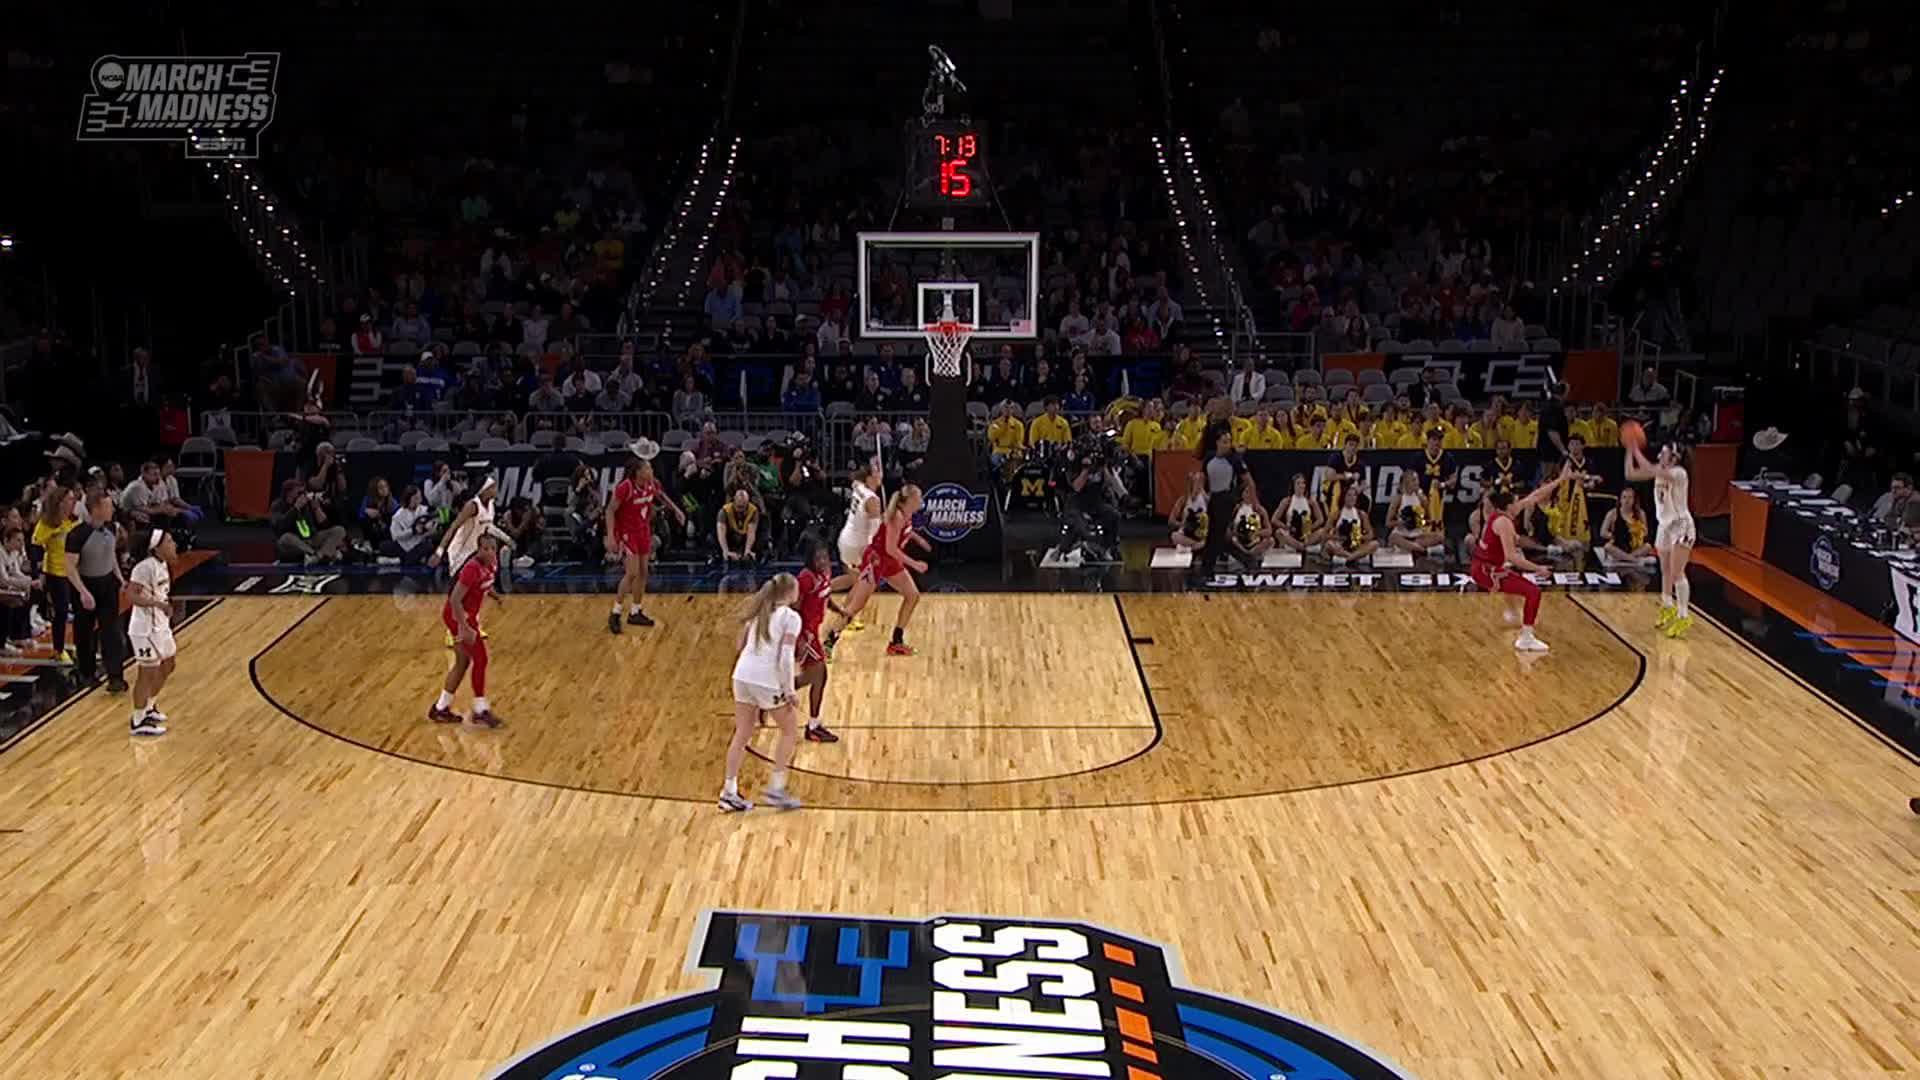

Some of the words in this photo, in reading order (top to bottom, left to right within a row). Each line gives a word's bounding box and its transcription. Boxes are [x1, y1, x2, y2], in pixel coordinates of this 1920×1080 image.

[935, 135, 976, 157] 7:13
[941, 160, 972, 196] 15
[1021, 479, 1045, 497] M
[926, 499, 967, 512] MARCH
[930, 511, 985, 523] MADNESS
[1206, 573, 1382, 587] SWEET
[1400, 572, 1623, 588] SIXEEN
[932, 921, 1113, 1080] NESS
